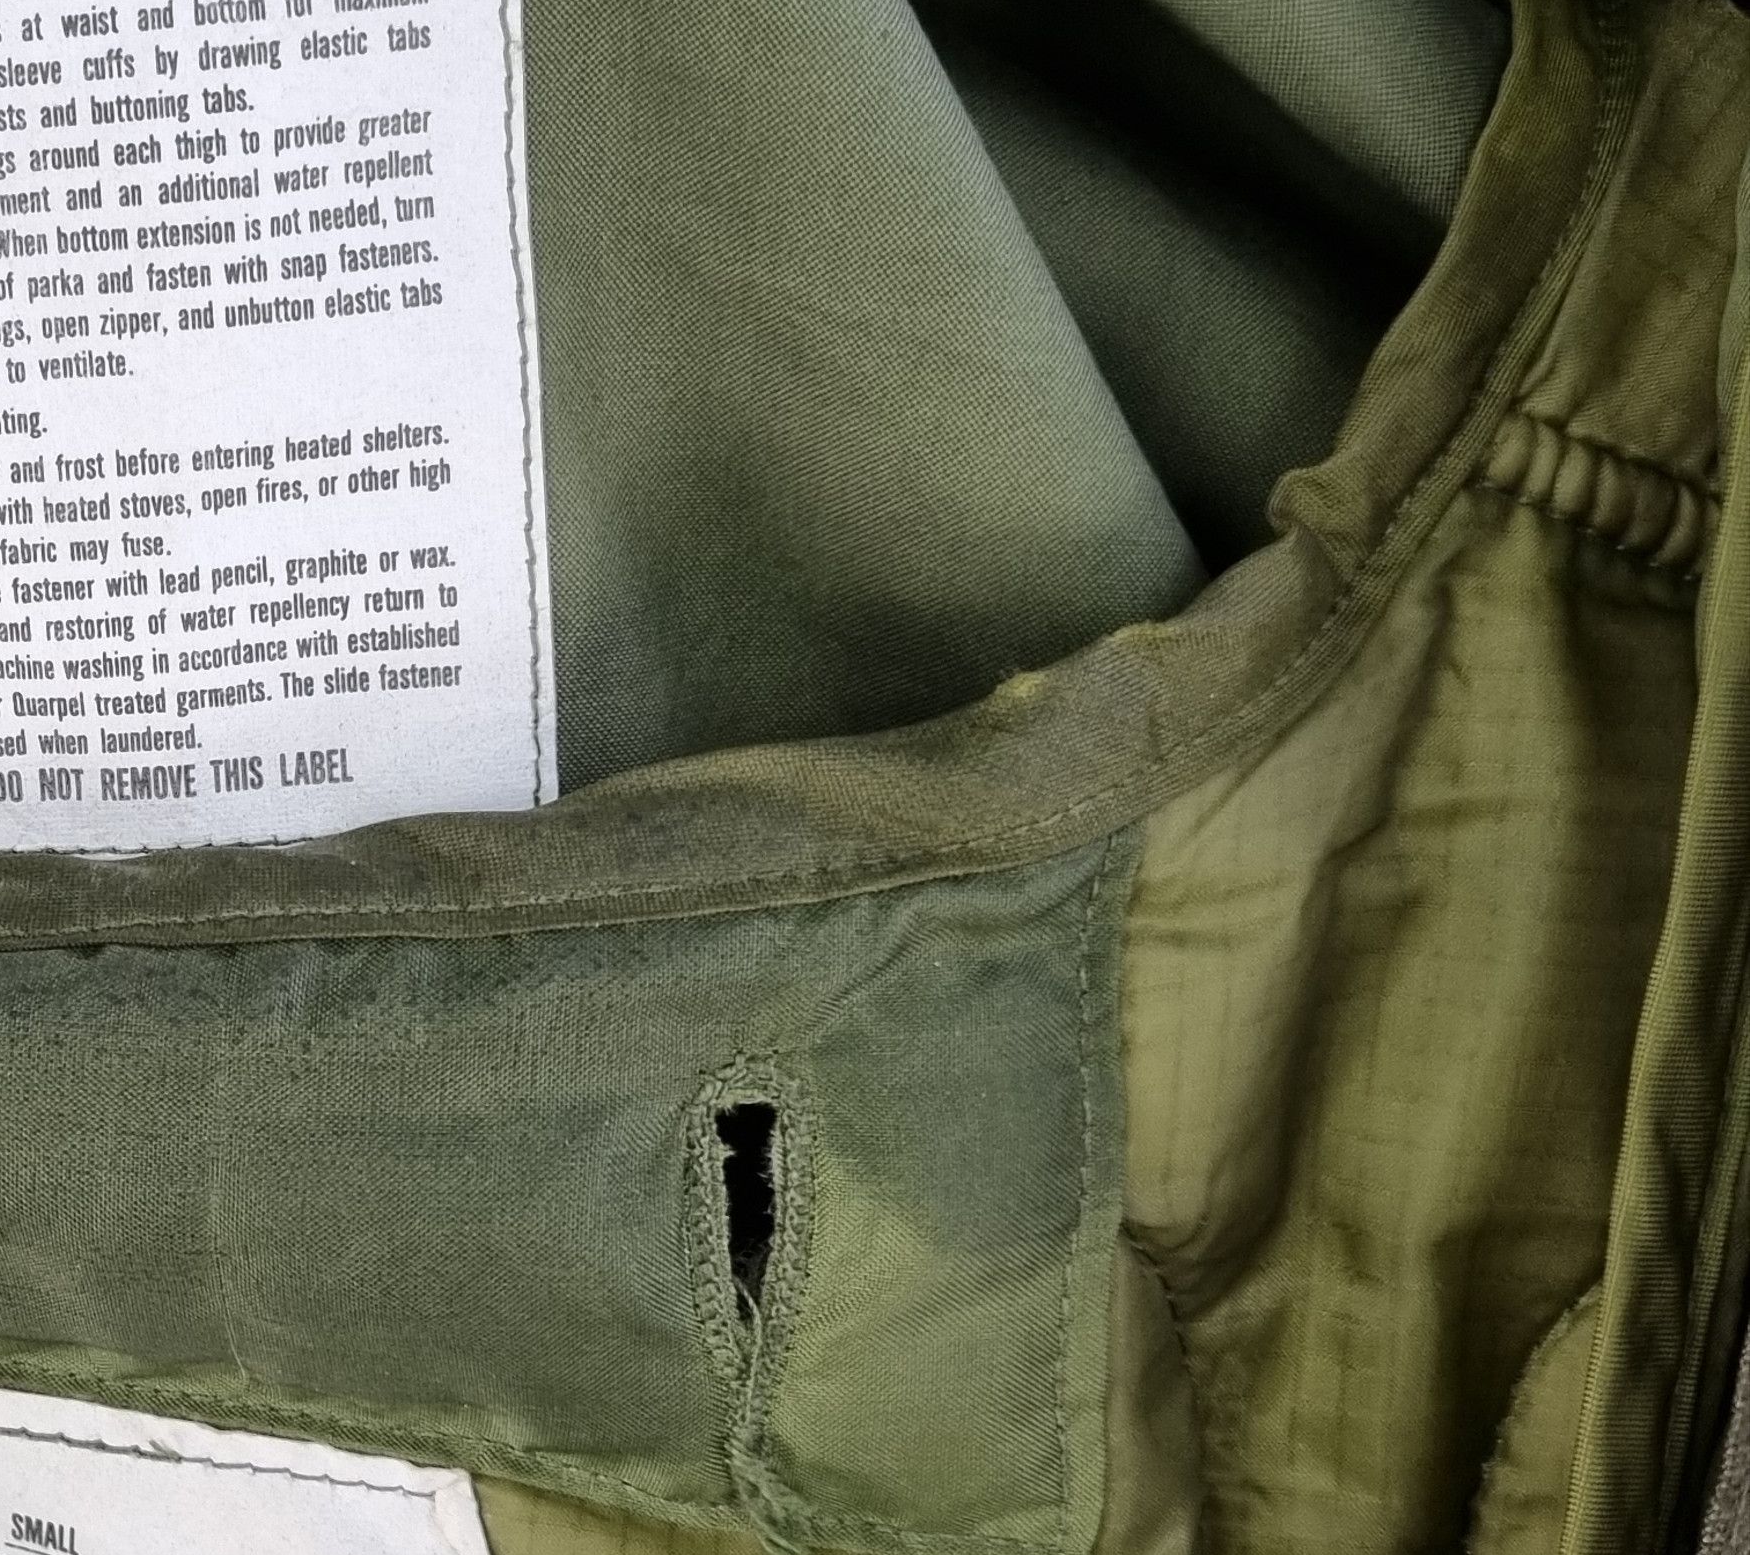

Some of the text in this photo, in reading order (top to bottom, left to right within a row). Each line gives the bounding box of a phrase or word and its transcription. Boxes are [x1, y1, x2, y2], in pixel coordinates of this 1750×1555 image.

[41, 315, 90, 344] open
[99, 307, 169, 341] zipper,
[178, 300, 215, 331] and
[224, 296, 315, 328] unbutton
[324, 286, 392, 319] elastic
[400, 277, 443, 309] tabs
[42, 492, 111, 524] heated
[119, 492, 192, 520] stoves,
[200, 486, 247, 516] open
[256, 477, 309, 504] fires,
[318, 475, 339, 497] or
[347, 465, 400, 494] other
[409, 457, 451, 493] high
[0, 537, 58, 566] fabric
[69, 539, 109, 565] may
[121, 531, 172, 558] fuse.
[37, 729, 89, 755] when
[100, 723, 203, 754] laundered.
[38, 767, 84, 802] NOT
[100, 763, 198, 802] REMOVE
[209, 755, 264, 794] THIS
[279, 747, 354, 787] LABEL
